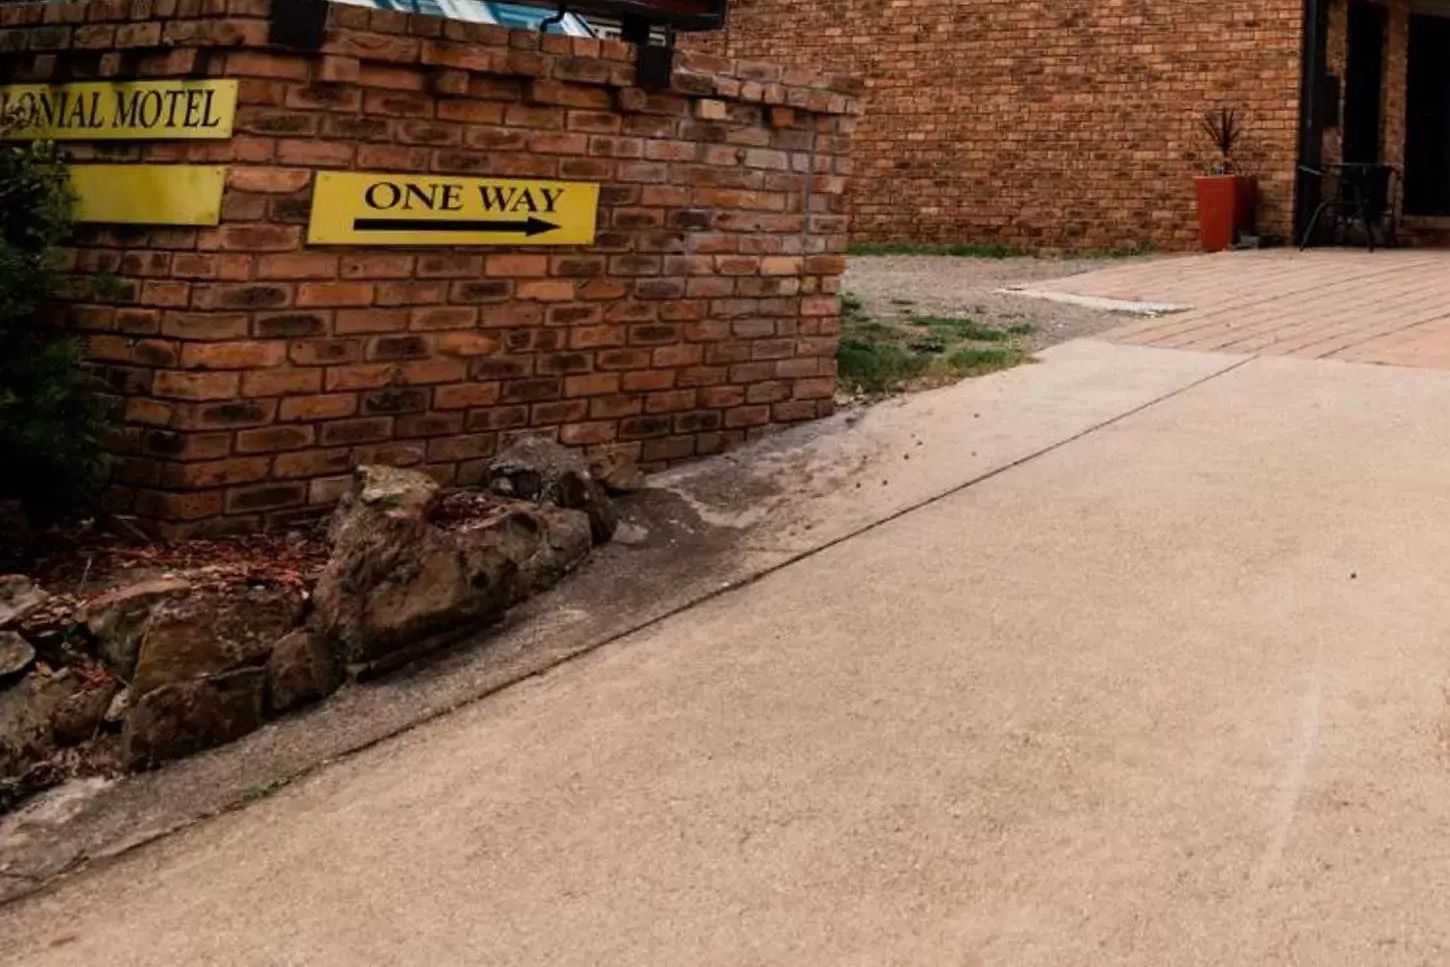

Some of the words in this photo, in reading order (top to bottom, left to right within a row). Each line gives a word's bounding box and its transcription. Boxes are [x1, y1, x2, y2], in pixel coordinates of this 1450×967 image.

[112, 89, 222, 129] MOTEL
[364, 181, 464, 212] ONE
[478, 185, 565, 214] WAY
